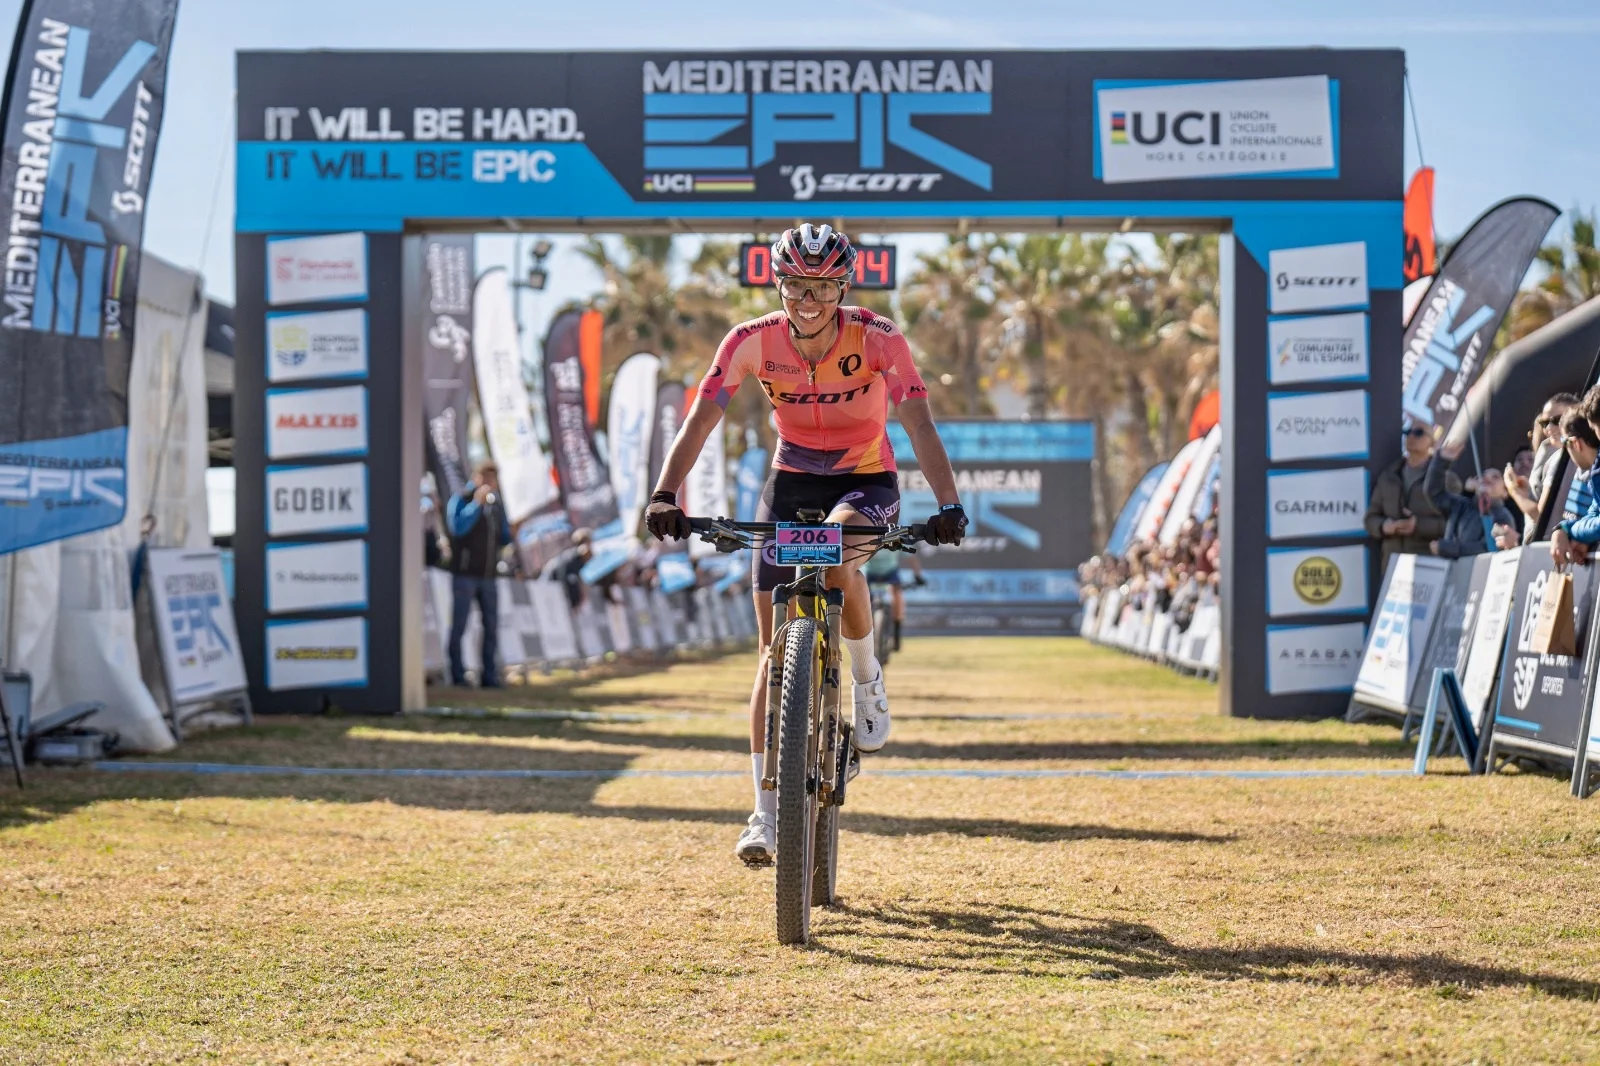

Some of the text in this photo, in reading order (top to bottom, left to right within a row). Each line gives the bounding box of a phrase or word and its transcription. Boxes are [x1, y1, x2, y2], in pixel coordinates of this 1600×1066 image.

[643, 60, 993, 93] MEDITERRANEAN
[264, 107, 585, 142] IT WILL BE HARD.
[1229, 110, 1270, 121] UNION
[1229, 122, 1278, 134] CYCLISTE
[123, 80, 154, 189] SCOTT
[1132, 111, 1221, 146] UCI
[1229, 135, 1324, 147] INTERNATIONALE
[643, 92, 992, 192] EPIC
[2, 17, 72, 330] MEDITERRANEAN
[267, 149, 556, 183] IT WILL BE EPIC
[31, 25, 158, 338] EPIC
[651, 174, 694, 192] UCI
[817, 173, 942, 192] SCOTT
[1292, 275, 1361, 287] SCOTT
[104, 299, 121, 332] UCI
[851, 313, 893, 334] SHIMANO
[776, 380, 875, 405] SCOTT
[275, 413, 360, 430] MAXXIS
[274, 486, 354, 513] GOBIK
[1275, 499, 1358, 515] GARMIN
[790, 529, 828, 544] 206
